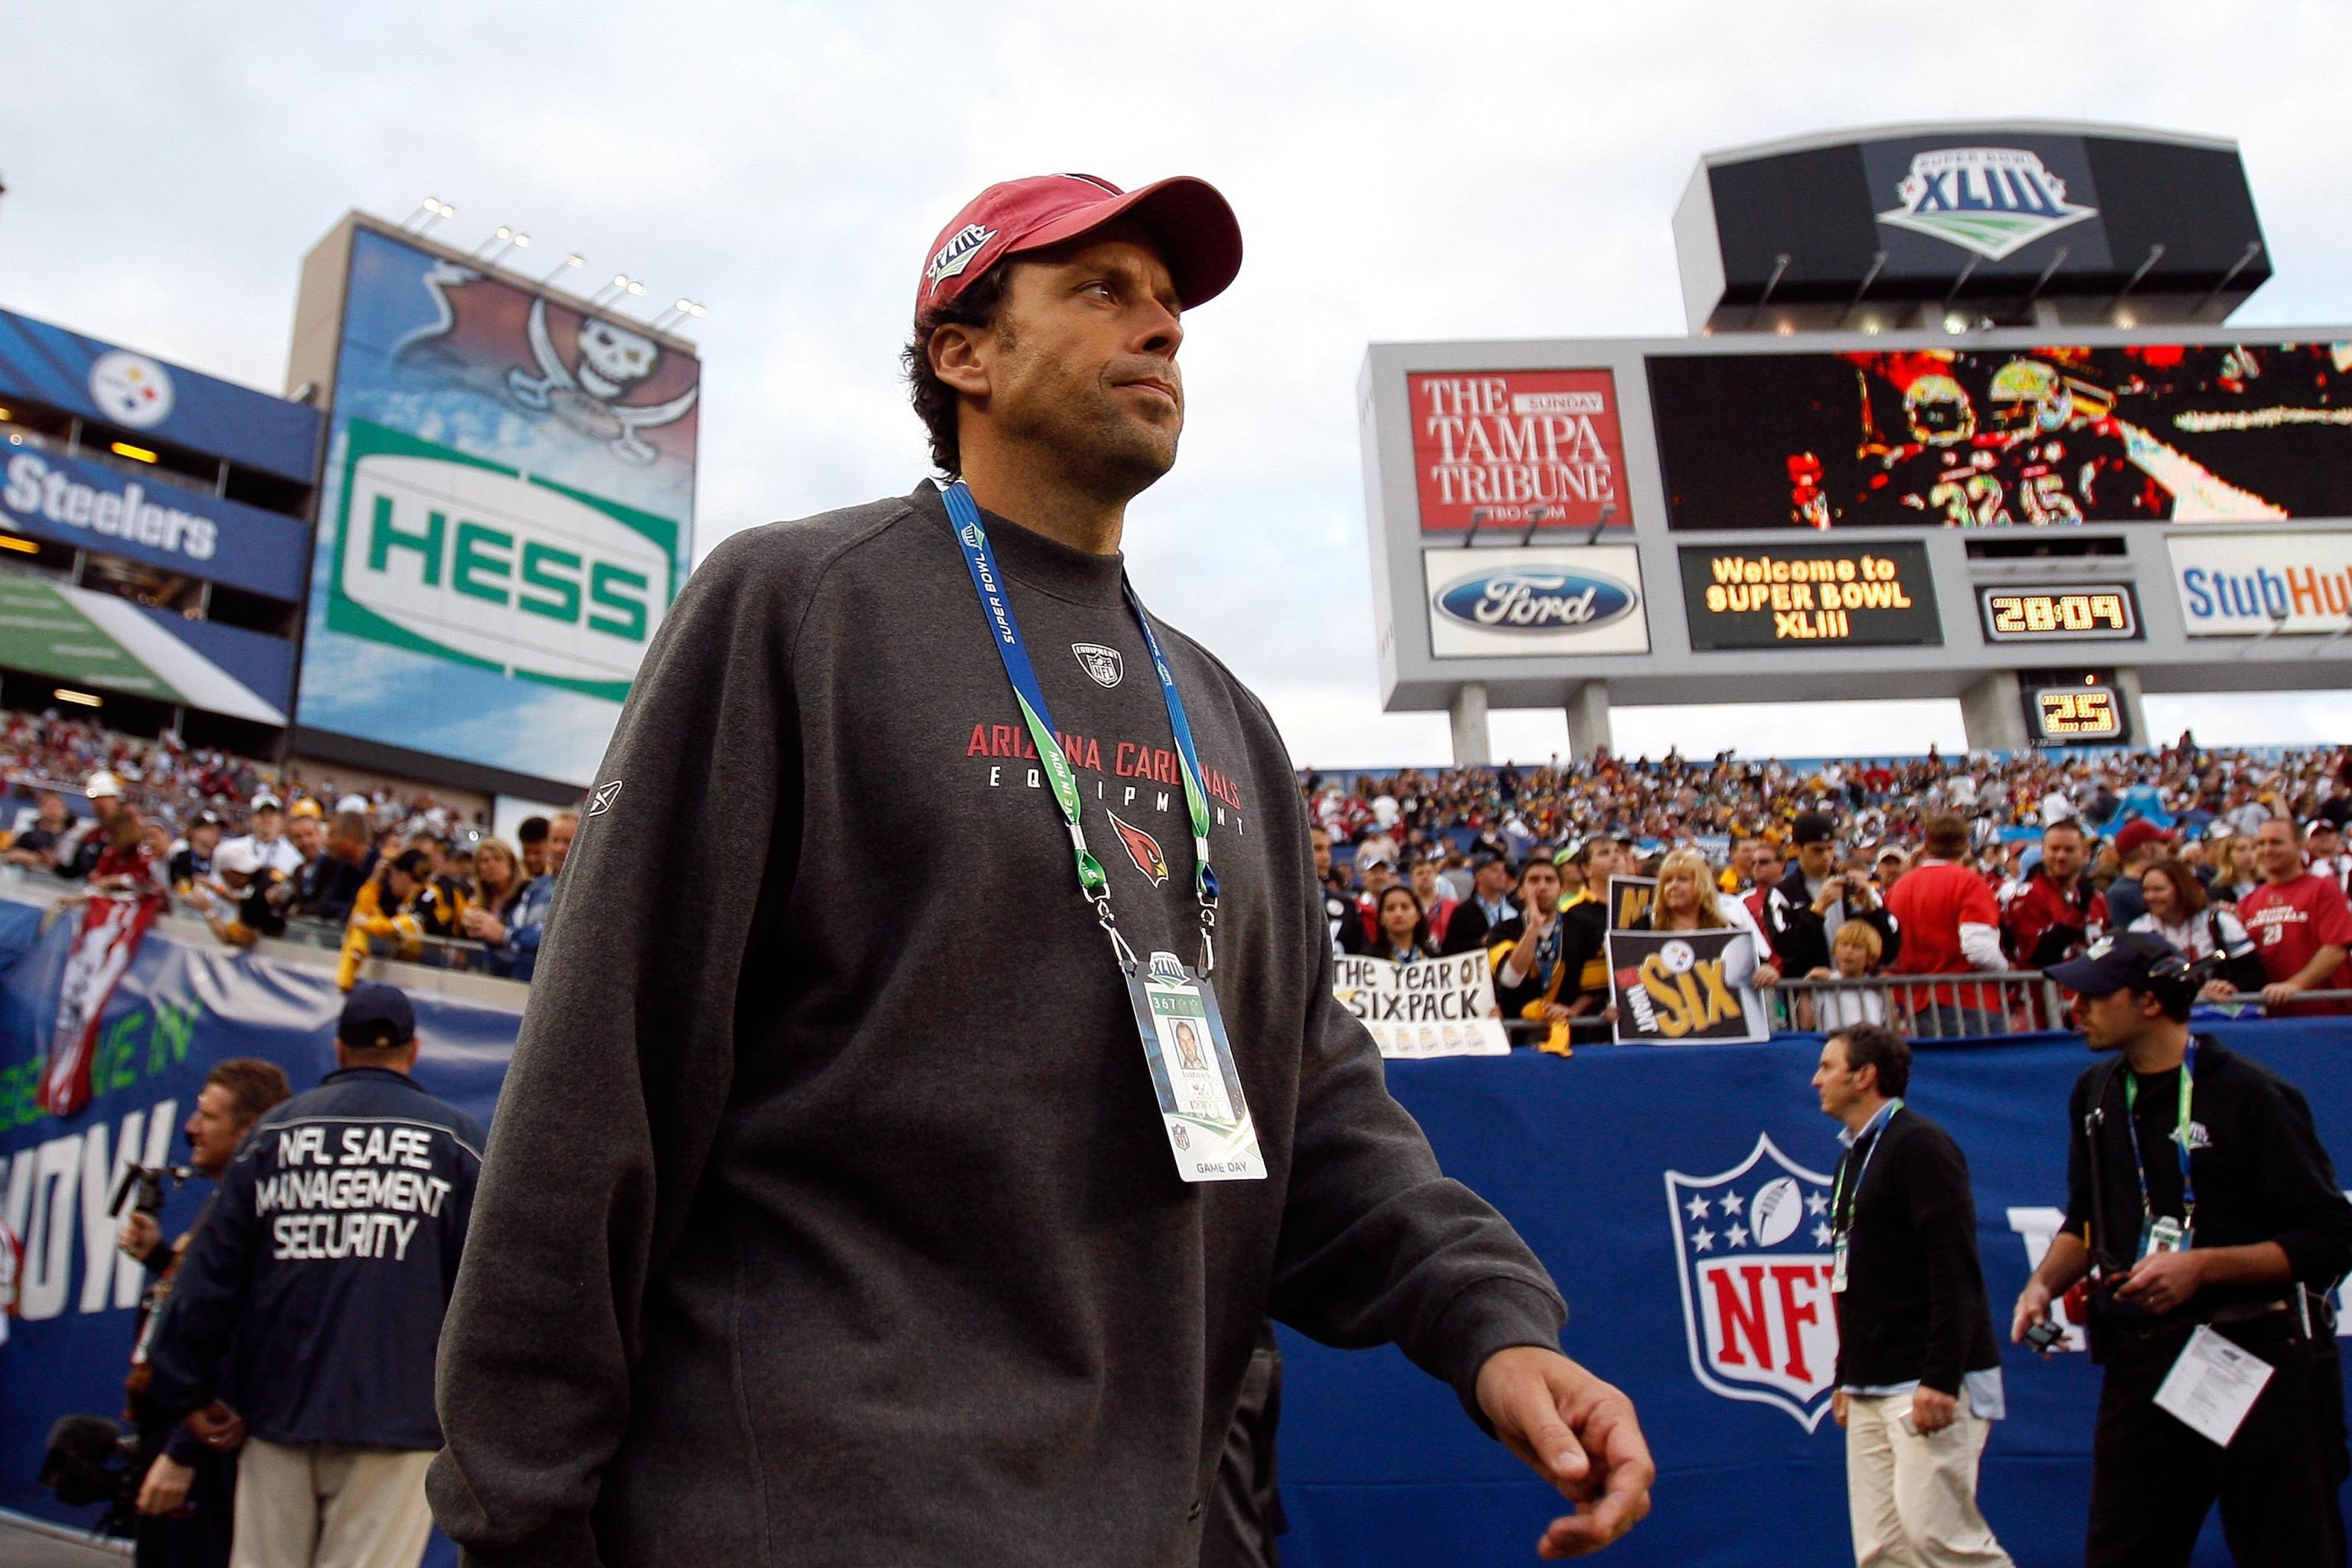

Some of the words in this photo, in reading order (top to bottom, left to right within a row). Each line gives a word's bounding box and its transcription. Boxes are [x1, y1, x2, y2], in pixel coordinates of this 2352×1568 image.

[1914, 165, 2067, 219] XLIII
[1422, 377, 1510, 416] THE
[1426, 413, 1610, 464] TAMPA
[3, 453, 218, 561] Steelers
[1430, 462, 1615, 505] TRIBUNE
[368, 494, 648, 643] HESS
[975, 553, 997, 593] BOWL
[1712, 555, 1856, 584] Welcome
[1859, 554, 1896, 581] to
[2184, 564, 2352, 619] StubHu
[1473, 576, 1598, 625] Ford
[1705, 583, 1815, 612] SUPER
[1818, 581, 1911, 610] BOWL
[1992, 596, 2124, 631] 28:09
[988, 596, 1015, 645] SUPER
[1773, 609, 1851, 639] XLIII
[2041, 692, 2112, 733] 25
[966, 723, 1102, 773] ARINA
[1115, 741, 1241, 812] CARNALS
[988, 766, 1243, 837] EQIPMNT
[1460, 956, 1486, 985] OF
[1152, 997, 1176, 1009] 367
[1640, 952, 1743, 1037] SIX
[277, 1125, 334, 1169] NFL
[339, 1125, 433, 1170] SAFE
[1196, 1163, 1226, 1174] GAME
[1227, 1161, 1247, 1172] DAY
[255, 1168, 454, 1217] MANAGEMENT
[273, 1213, 420, 1262] SECURITY
